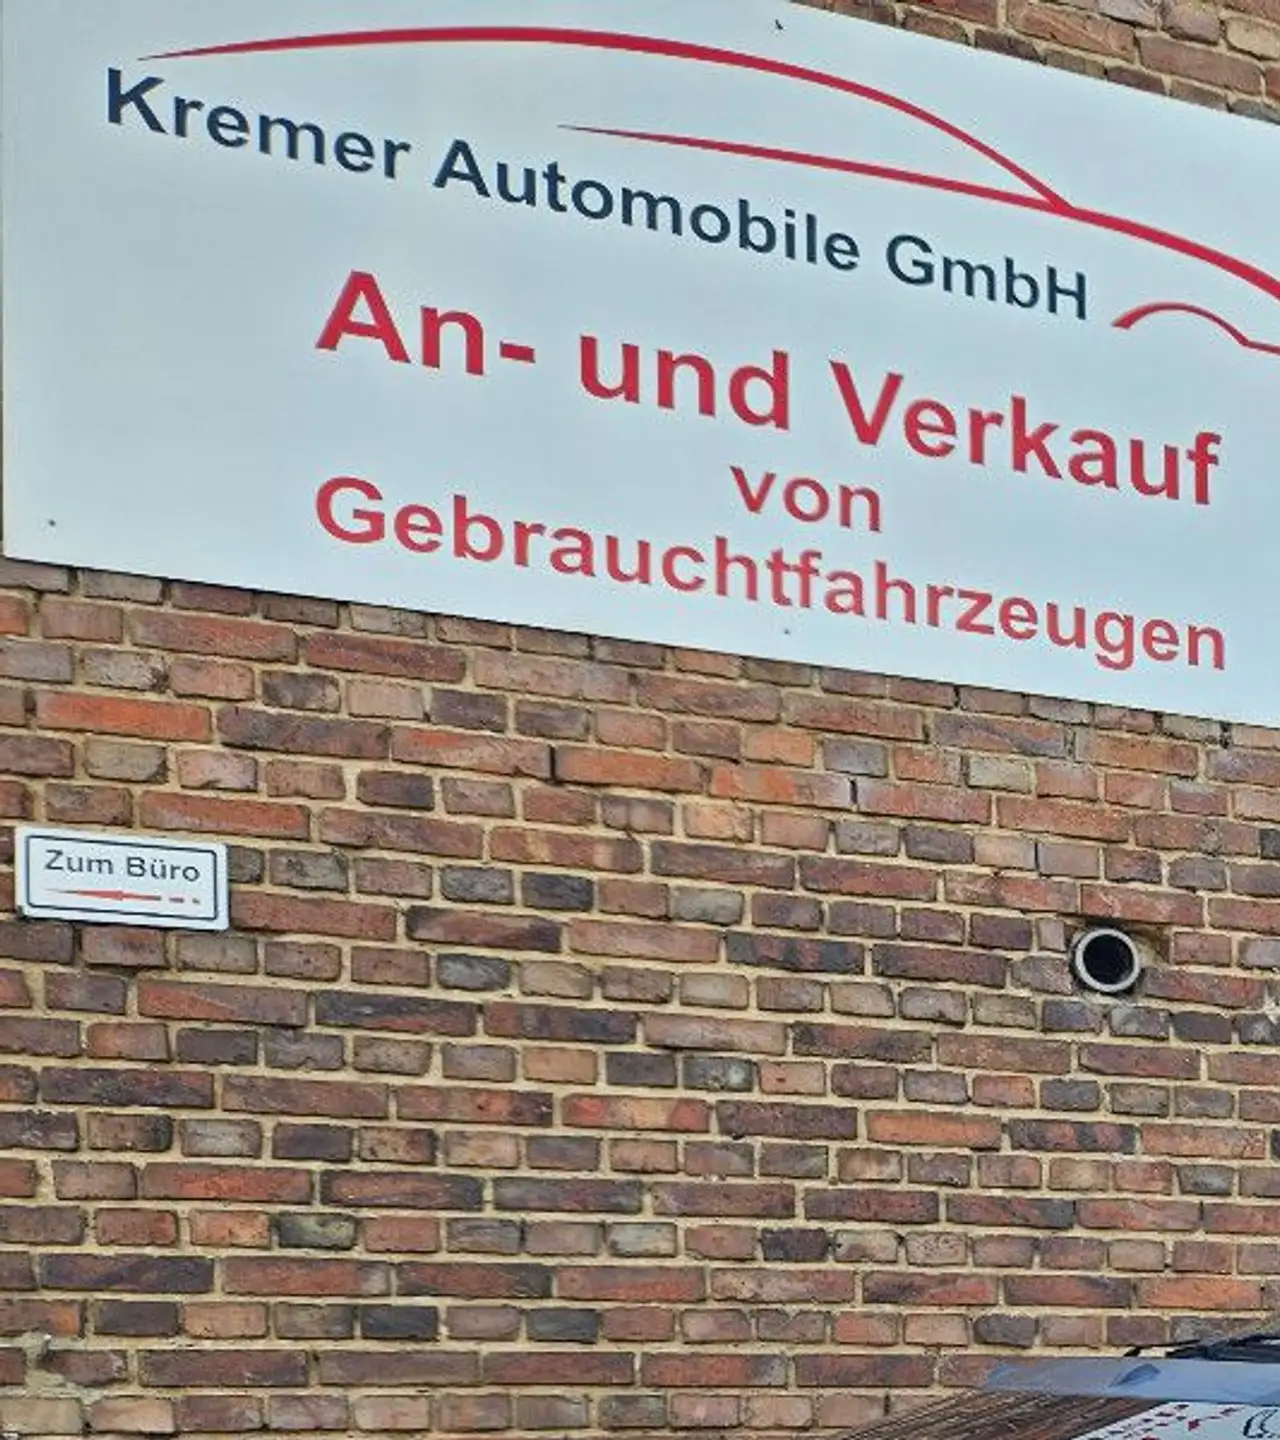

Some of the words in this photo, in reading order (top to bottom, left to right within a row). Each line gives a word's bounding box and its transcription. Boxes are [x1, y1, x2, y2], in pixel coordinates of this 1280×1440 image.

[107, 66, 412, 180] Kremer
[432, 138, 862, 273] Automobile
[885, 233, 1089, 321] GmbH
[316, 270, 537, 377] An-
[579, 335, 791, 431] und
[831, 360, 1222, 507] Verkauf
[315, 476, 1228, 671] Gebrauchtfahrzeugen
[730, 465, 882, 531] von
[44, 849, 114, 876] Zum
[126, 856, 201, 883] Büro
